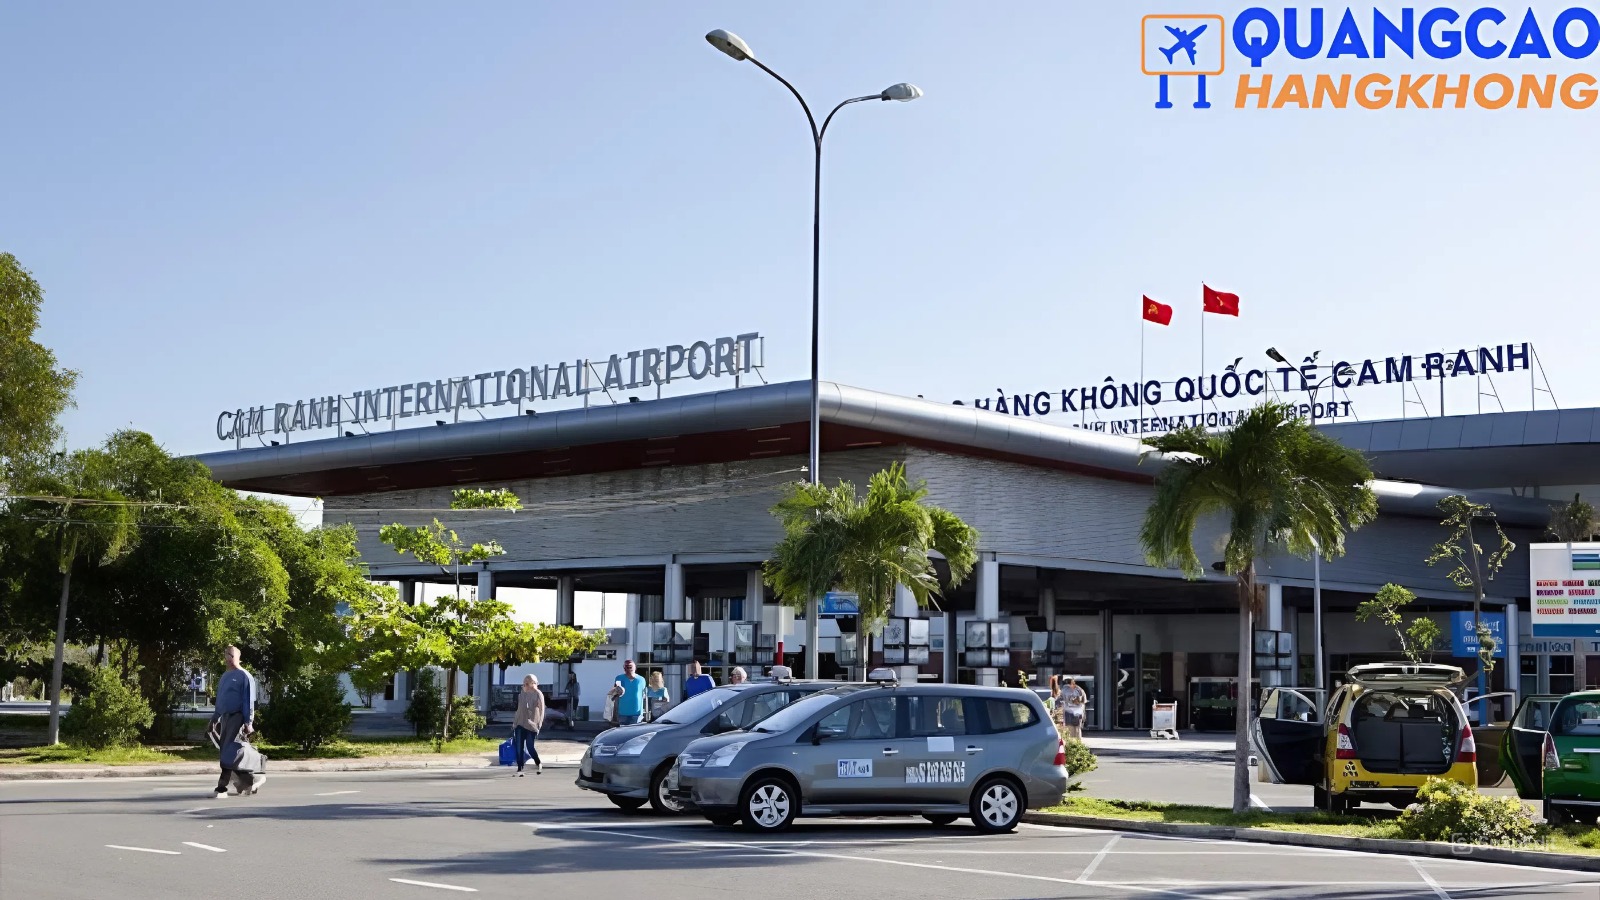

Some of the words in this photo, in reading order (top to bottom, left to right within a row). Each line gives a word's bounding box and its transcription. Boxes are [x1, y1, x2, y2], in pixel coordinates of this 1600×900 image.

[217, 405, 264, 440] CAM
[274, 395, 342, 434] RANH
[353, 359, 592, 423] INTERNATIONAL
[602, 332, 759, 392] AIRPORT
[1061, 376, 1161, 412] KHÔNG
[1175, 357, 1264, 401] QUỐC
[1333, 355, 1413, 389] CAM
[1425, 342, 1529, 381] RANH
